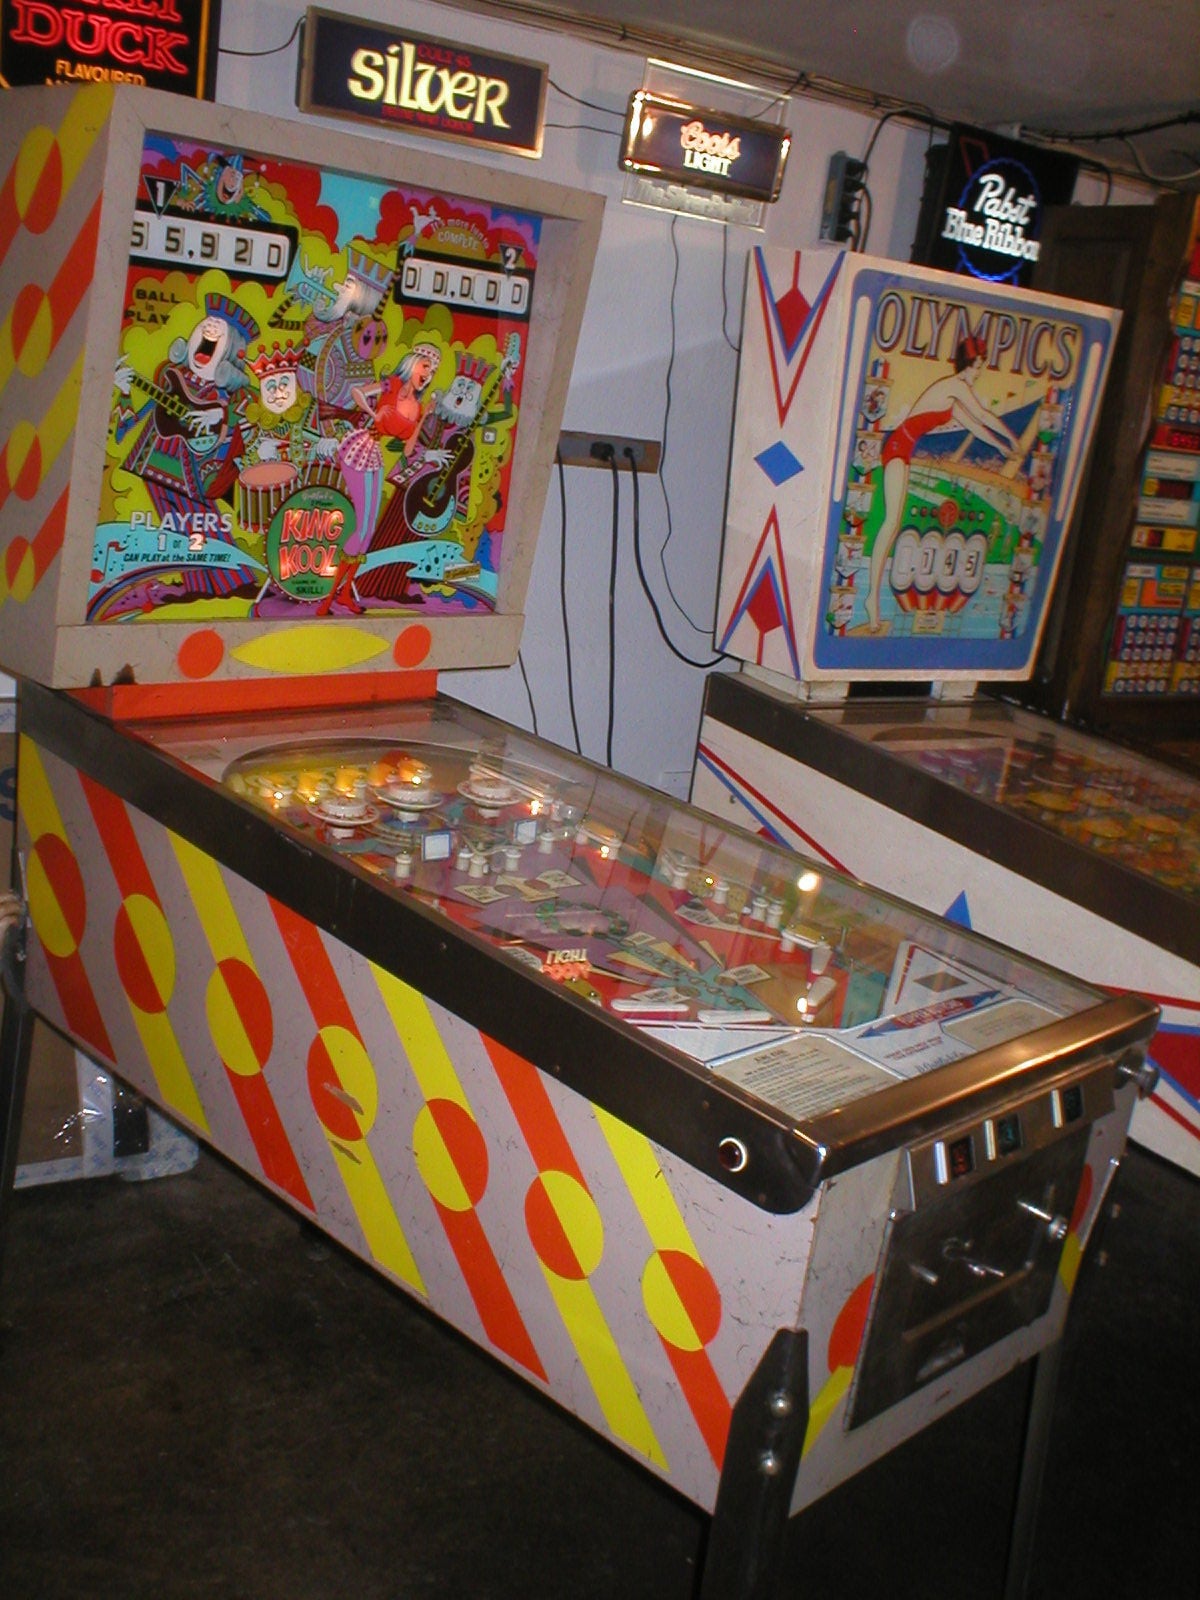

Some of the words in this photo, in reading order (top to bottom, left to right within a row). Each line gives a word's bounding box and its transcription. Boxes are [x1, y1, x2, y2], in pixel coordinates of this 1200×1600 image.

[9, 1, 190, 75] DUCK
[55, 58, 147, 86] FLAVOURED
[683, 149, 732, 176] LIGHT
[155, 181, 166, 207] 1
[974, 173, 1037, 225] Pabst
[438, 231, 480, 250] COMPETE
[941, 206, 984, 247] Blue
[982, 217, 1042, 262] Ribbon
[505, 248, 516, 269] 2
[135, 288, 181, 303] BALL
[124, 309, 171, 325] PLAY
[875, 291, 1077, 381] OLYMPICS
[129, 511, 233, 532] PLAYERS
[280, 508, 344, 543] KING
[158, 533, 167, 551] 1
[188, 533, 204, 552] 2
[123, 553, 140, 562] CAN
[141, 554, 162, 562] PLAY
[172, 553, 184, 562] the
[186, 554, 208, 563] SAME
[209, 554, 231, 563] TIME!
[279, 544, 338, 580] KOOL
